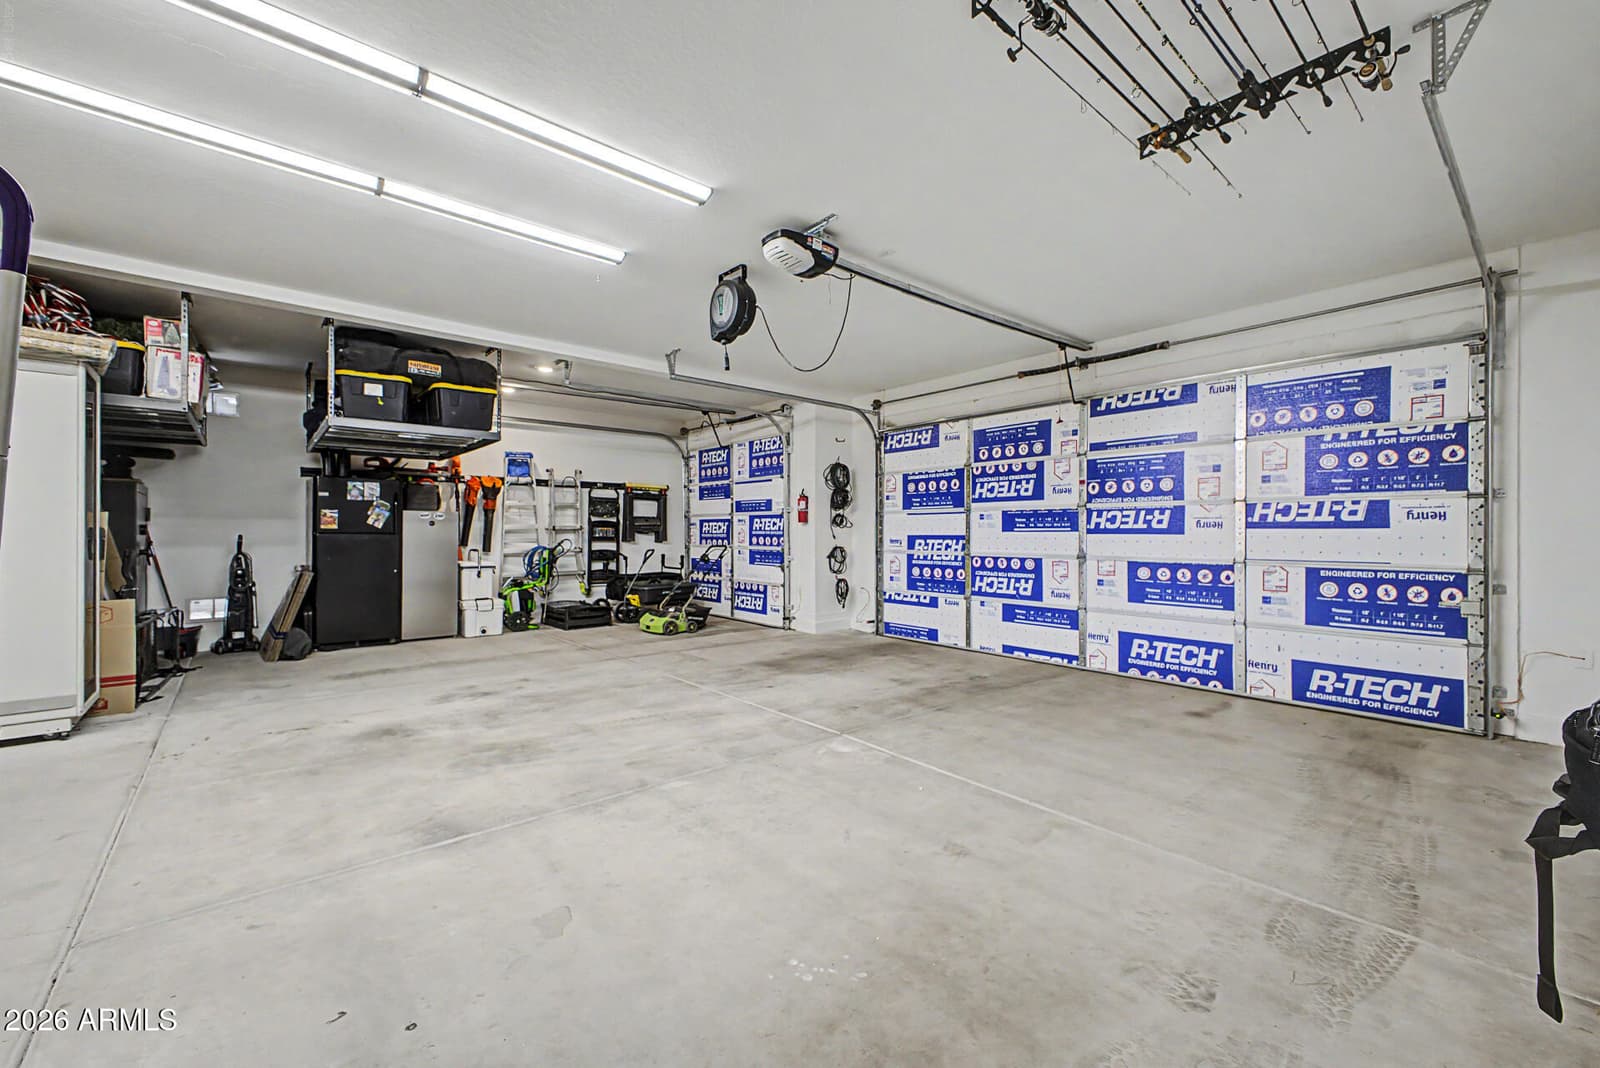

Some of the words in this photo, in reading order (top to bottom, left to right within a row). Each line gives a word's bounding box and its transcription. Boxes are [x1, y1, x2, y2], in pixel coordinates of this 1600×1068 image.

[887, 428, 933, 450] R-TECH
[1320, 439, 1375, 450] ENGINEERED
[1378, 437, 1397, 445] FOR
[1400, 432, 1456, 443] EFFICIENCY
[973, 479, 1035, 499] R-TECH
[1090, 508, 1171, 529] R-TECH
[1195, 519, 1223, 529] Henry
[1406, 510, 1447, 521] Henry
[1320, 570, 1375, 578] ENGINEERED
[1377, 571, 1395, 579] FOR
[1398, 572, 1456, 582] EFFICIENCY
[972, 576, 1033, 596] R-TECH
[1087, 632, 1109, 643] Henry
[1130, 638, 1219, 669] R-TECH
[1128, 657, 1165, 669] ENGINEERED
[1180, 666, 1217, 676] EFFICIENCY
[1248, 659, 1278, 673] Henry
[1309, 668, 1443, 709] R-TECH
[1306, 692, 1360, 706] ENGINEERED
[1362, 700, 1381, 709] FOR
[1383, 702, 1440, 718] EFFICIENCY
